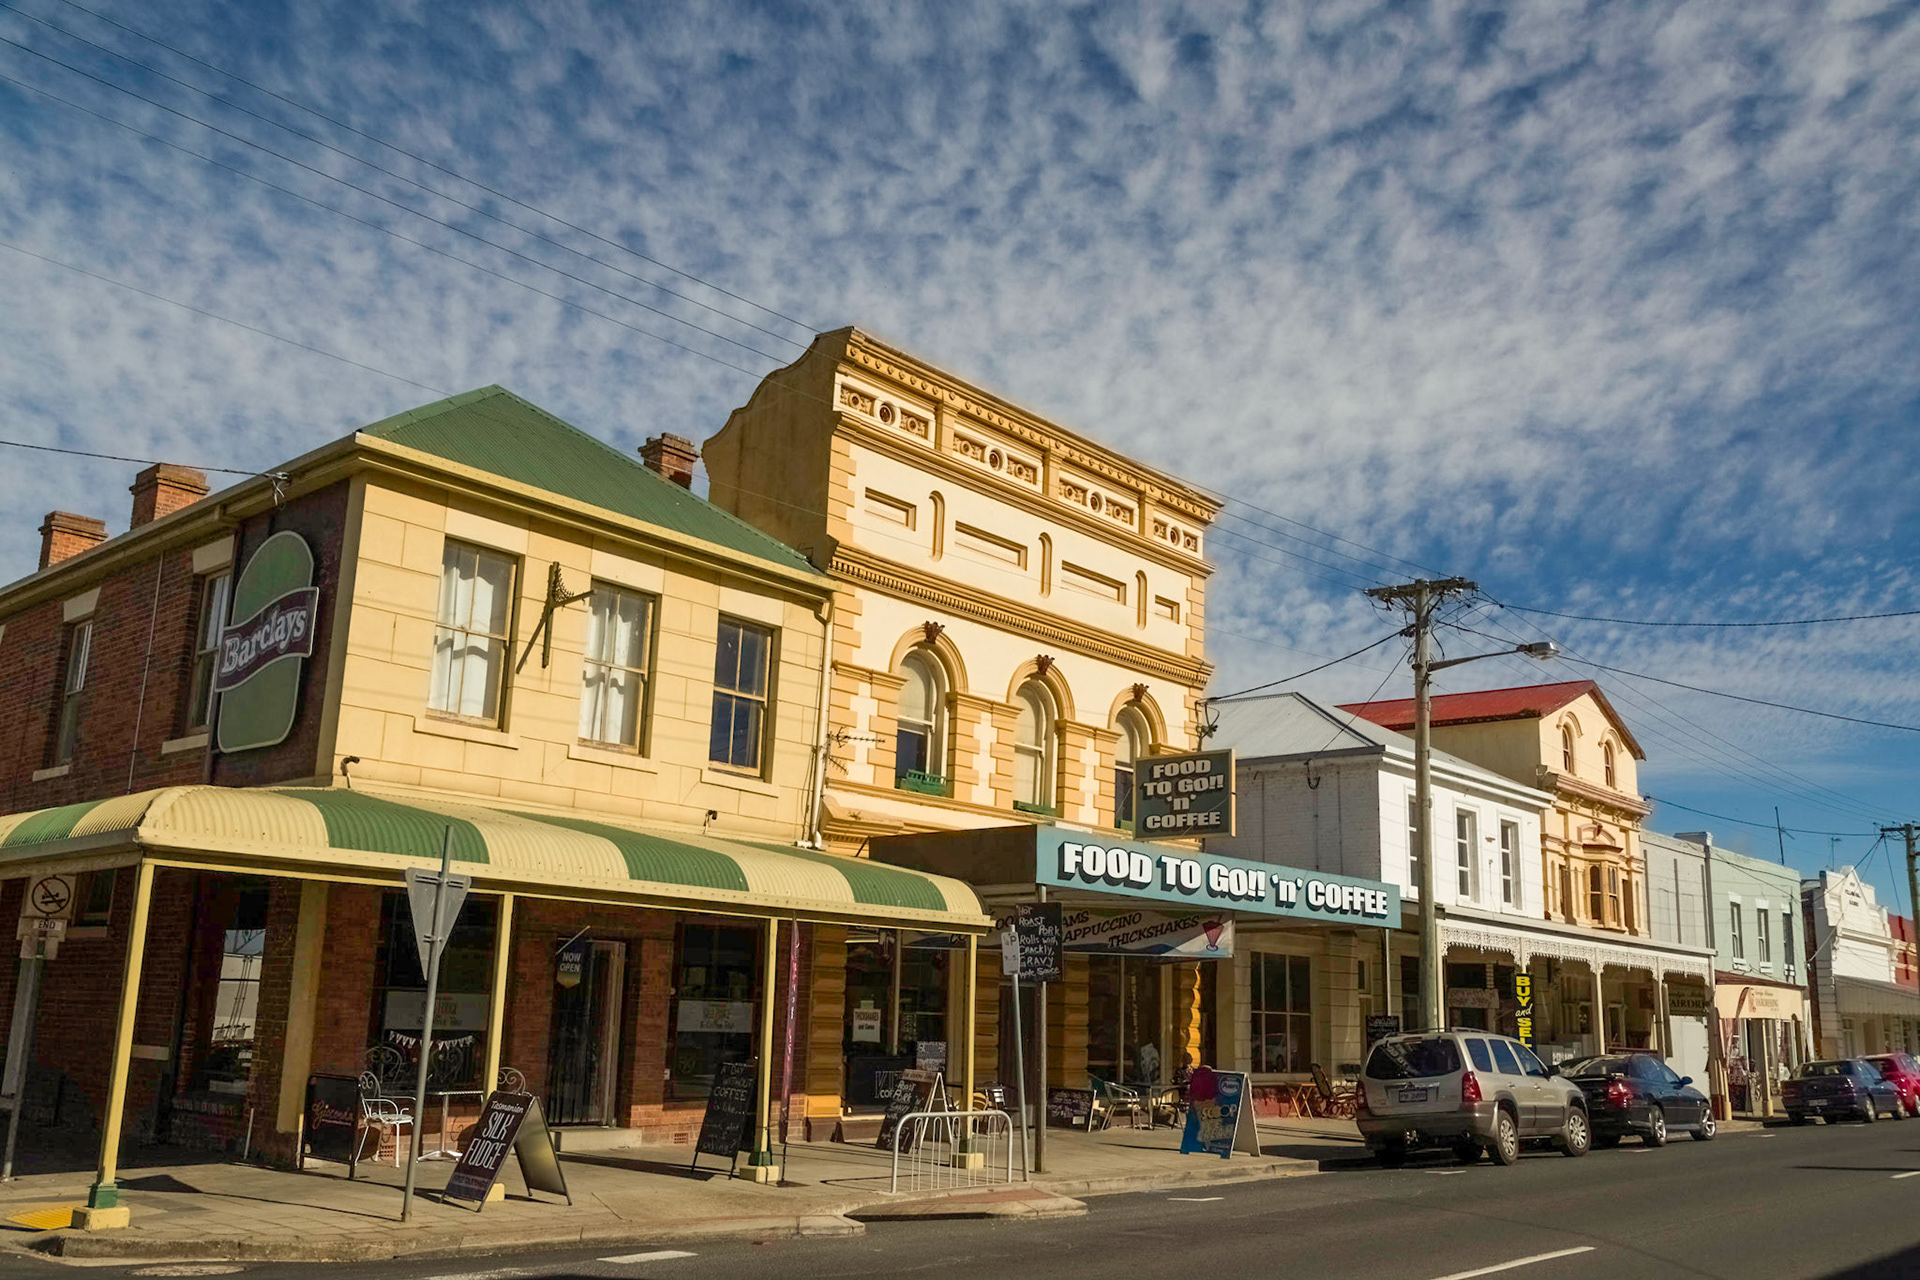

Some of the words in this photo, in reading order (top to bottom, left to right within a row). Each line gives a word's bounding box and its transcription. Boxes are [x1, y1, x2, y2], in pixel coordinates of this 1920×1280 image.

[220, 607, 308, 673] Barclays
[1152, 759, 1211, 779] FOOD
[1143, 780, 1172, 796] TO
[1177, 774, 1224, 793] GO!!
[1145, 811, 1221, 829] COFFEE
[1061, 841, 1152, 885] FOOD
[1160, 855, 1202, 890] TO
[1209, 862, 1266, 899] GO!!
[1308, 879, 1388, 918] COFFEE
[38, 920, 56, 929] END
[1063, 912, 1142, 943] APPUCCINO
[1107, 914, 1200, 949] THICKSHAKES
[560, 962, 581, 972] OPEN
[562, 951, 582, 962] NOW
[1515, 975, 1531, 1007] BUY
[1514, 1003, 1533, 1017] and
[1516, 1017, 1533, 1048] SEL
[713, 1086, 748, 1101] COFFEE
[490, 1100, 525, 1114] Tasmanian
[1200, 1103, 1237, 1120] SCOOP
[482, 1111, 515, 1140] SILK
[462, 1138, 506, 1170] FUDGE
